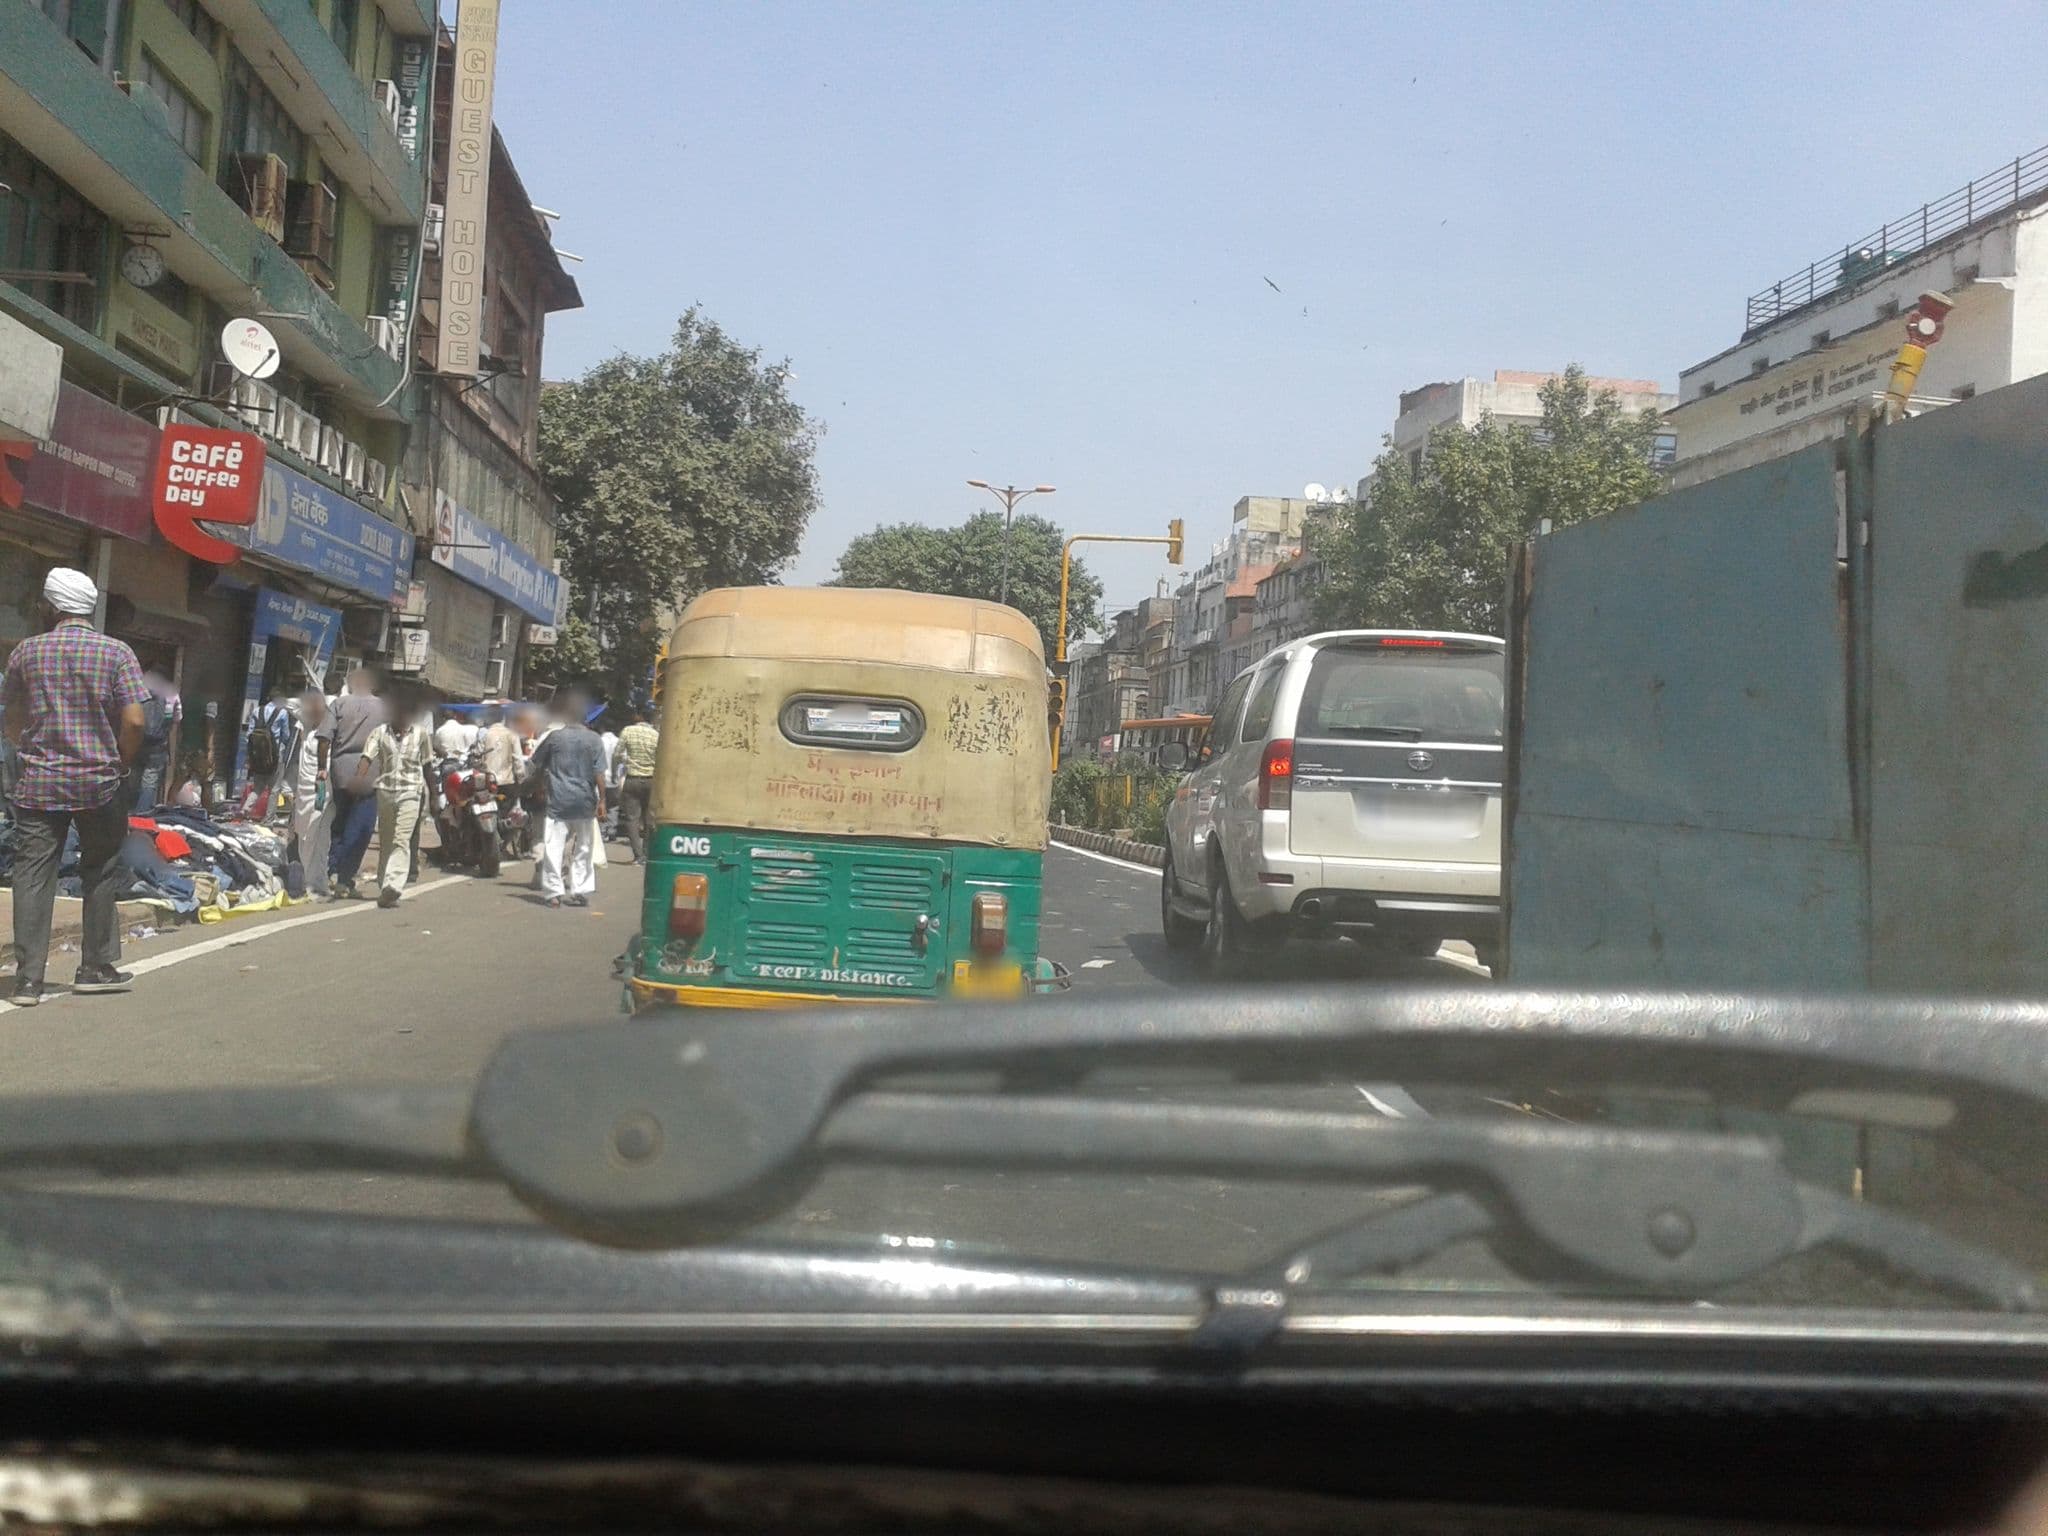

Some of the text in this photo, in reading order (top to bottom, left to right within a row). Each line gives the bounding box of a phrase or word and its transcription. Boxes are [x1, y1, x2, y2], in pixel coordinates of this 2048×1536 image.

[457, 48, 487, 194] GUEST
[449, 219, 476, 365] HOUSE
[172, 441, 244, 470] Café
[168, 464, 241, 488] Coffee
[165, 485, 206, 507] Day
[670, 835, 711, 856] CNG
